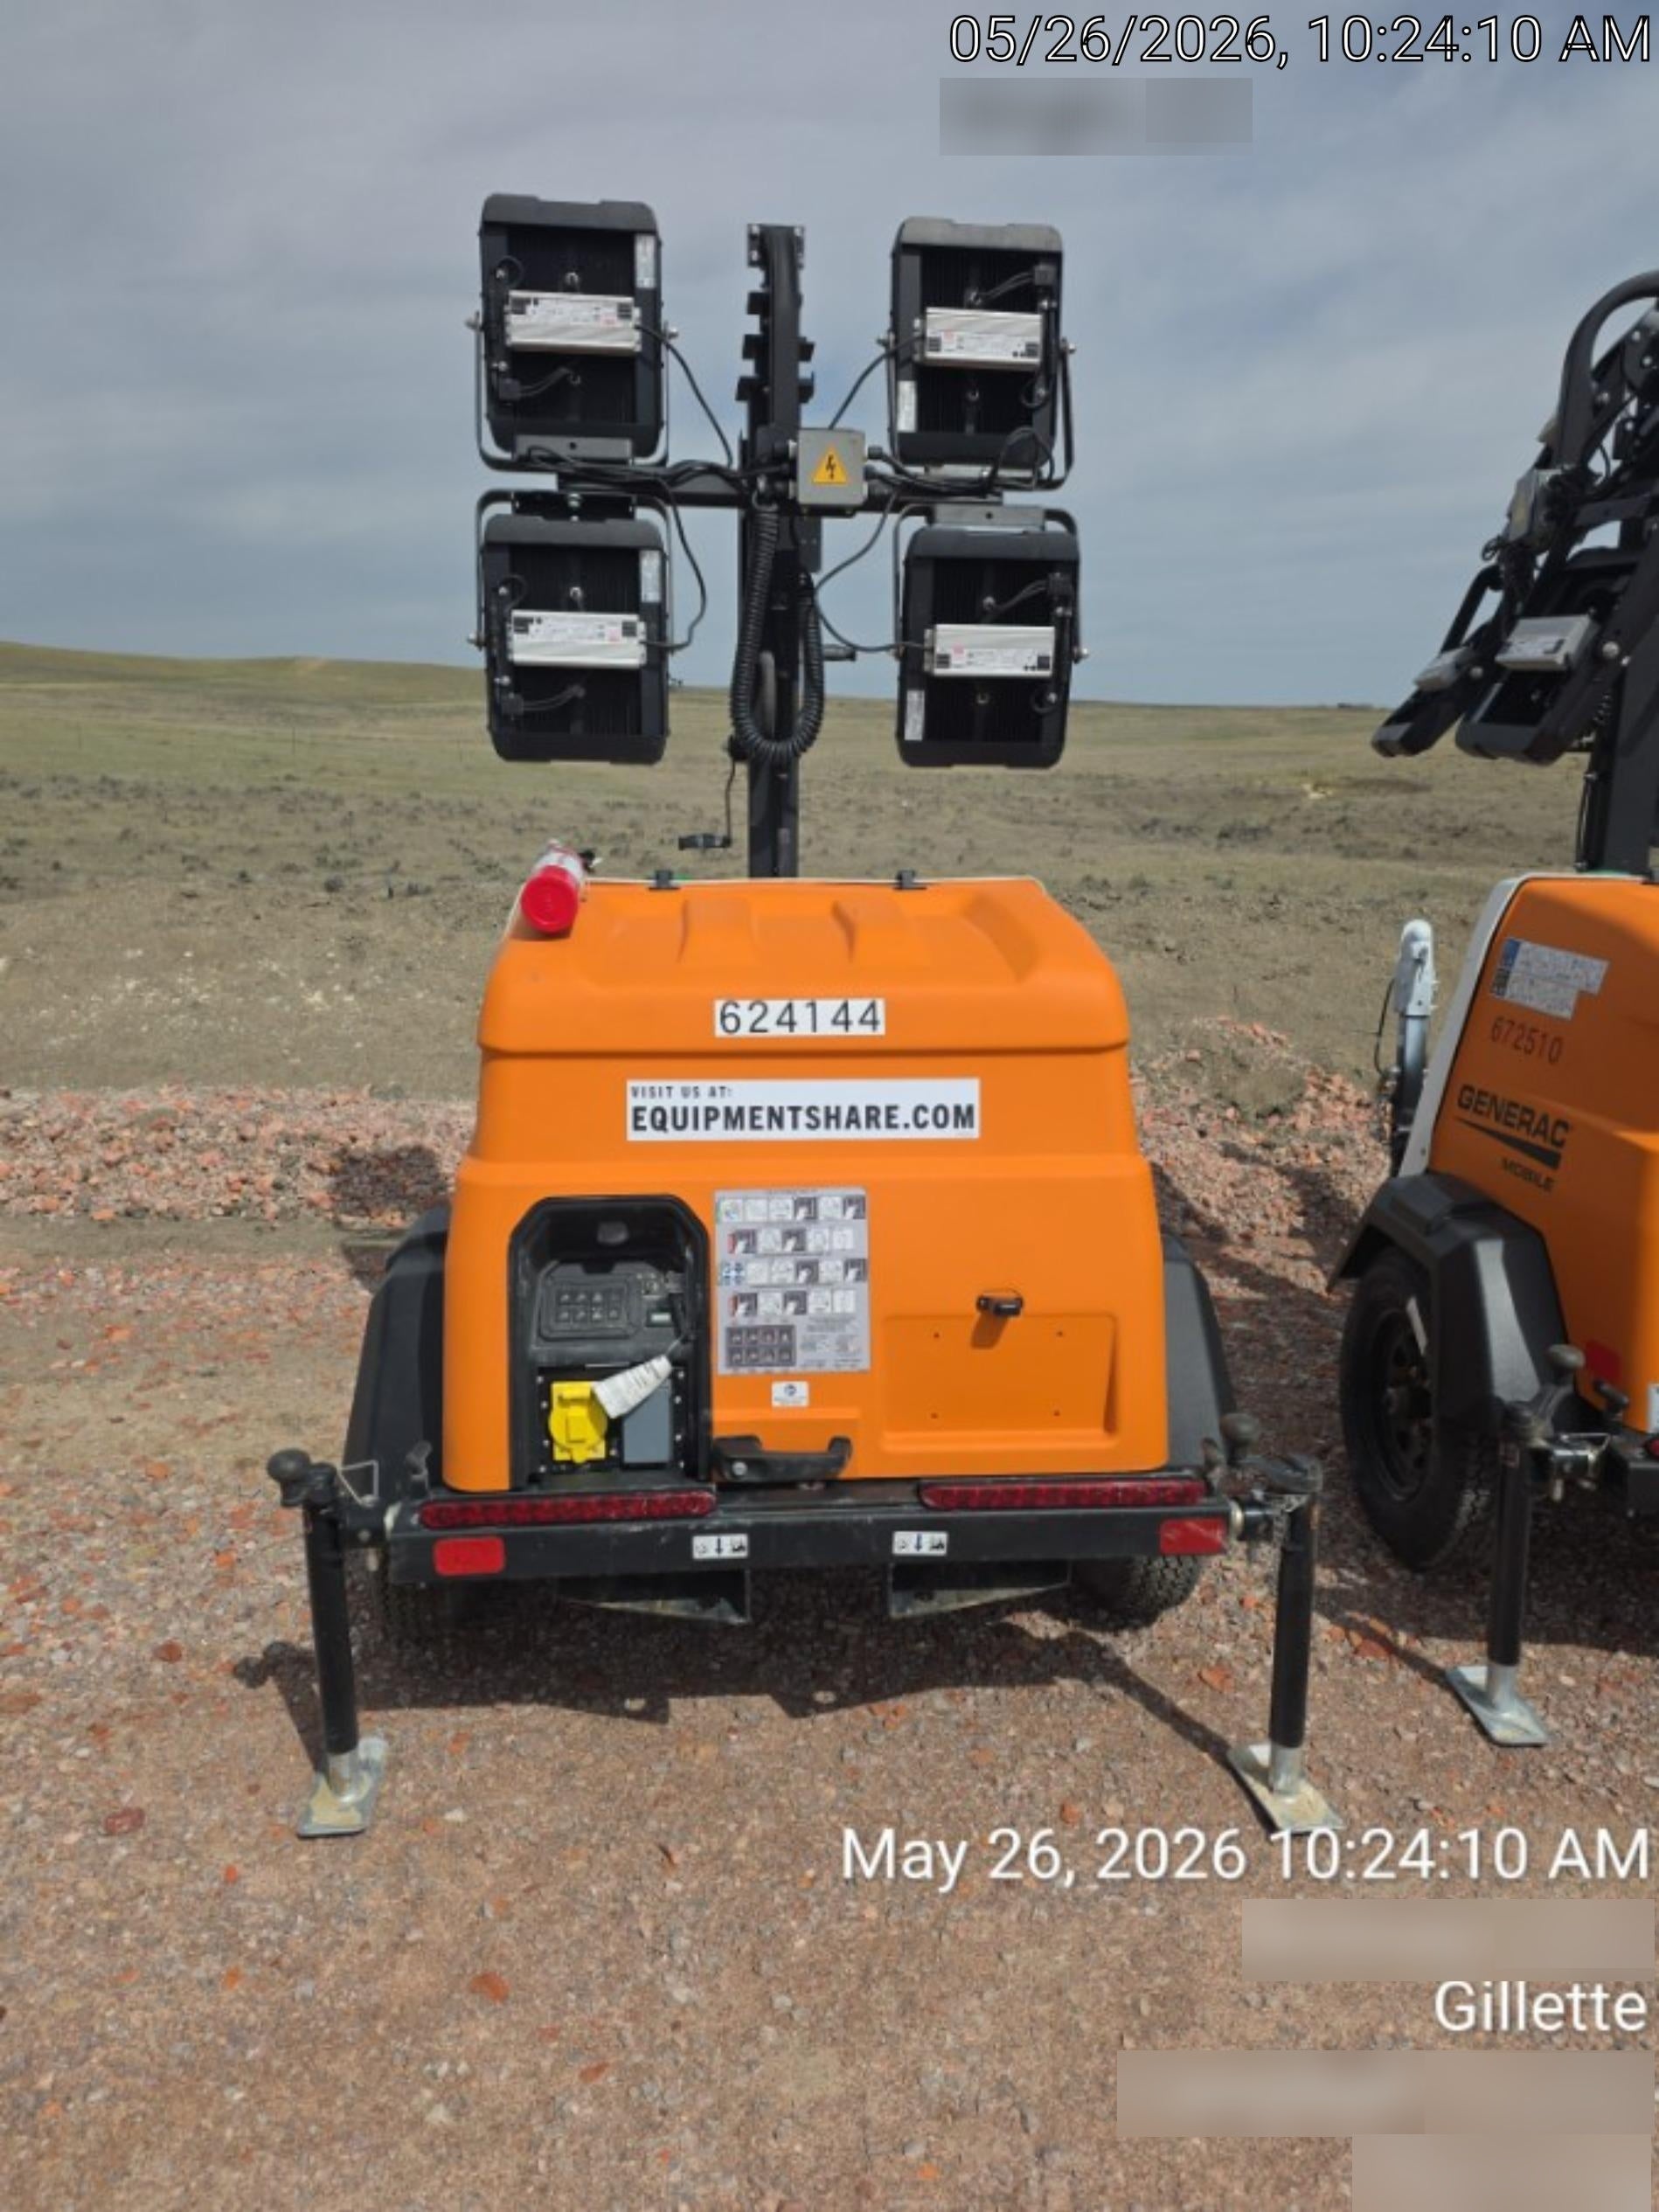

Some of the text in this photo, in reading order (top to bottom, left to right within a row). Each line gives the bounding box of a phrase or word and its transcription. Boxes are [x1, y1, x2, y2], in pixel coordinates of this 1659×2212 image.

[719, 1000, 880, 1033] 624144
[1491, 1015, 1564, 1065] 672510
[631, 1085, 674, 1099] VISIT
[681, 1085, 700, 1099] US
[633, 1104, 975, 1133] EQUIPMENTSHARE.COM
[1457, 1083, 1571, 1149] GENERAC
